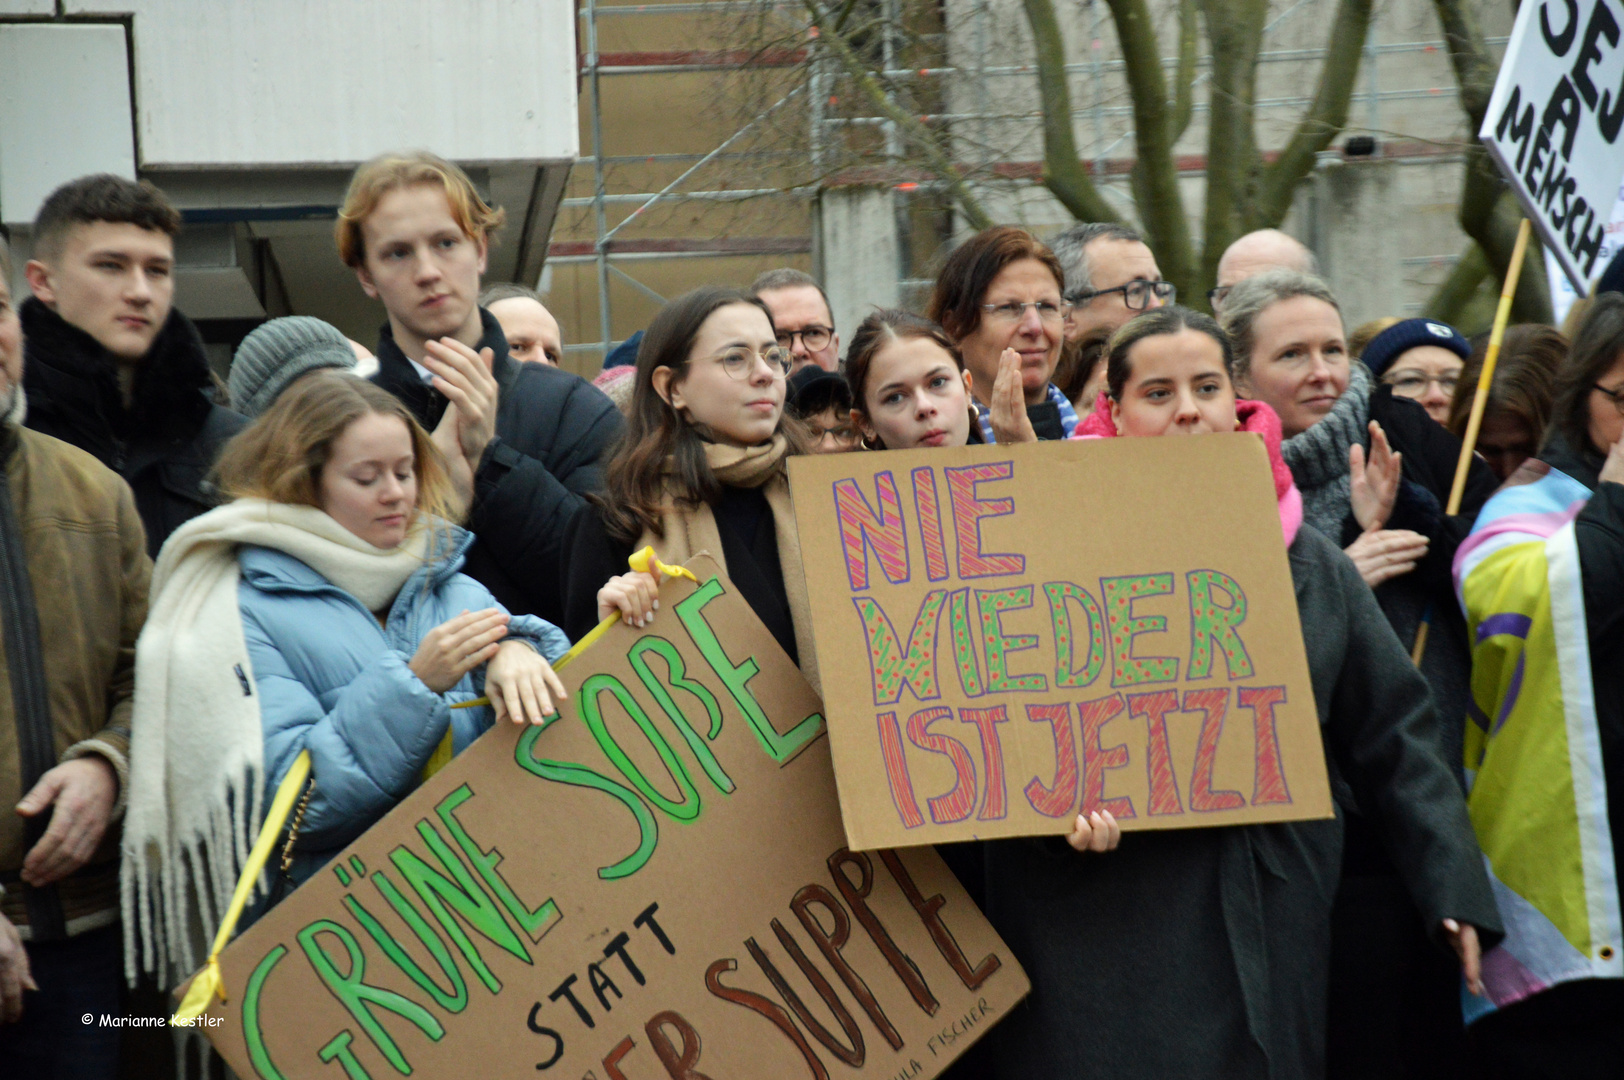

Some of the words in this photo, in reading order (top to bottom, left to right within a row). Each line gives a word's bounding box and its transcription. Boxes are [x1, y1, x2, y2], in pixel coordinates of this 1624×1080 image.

[1496, 84, 1604, 279] MENSCH
[1542, 74, 1581, 163] A
[832, 461, 1026, 591] NIE
[851, 569, 1255, 705] WIEDER
[876, 704, 1010, 828] IST
[1023, 685, 1293, 819] JETZT
[242, 782, 563, 1080] GRÜNE
[527, 902, 676, 1070] STATT
[705, 847, 1002, 1080] SUPPE
[927, 997, 994, 1056] FISCHER
